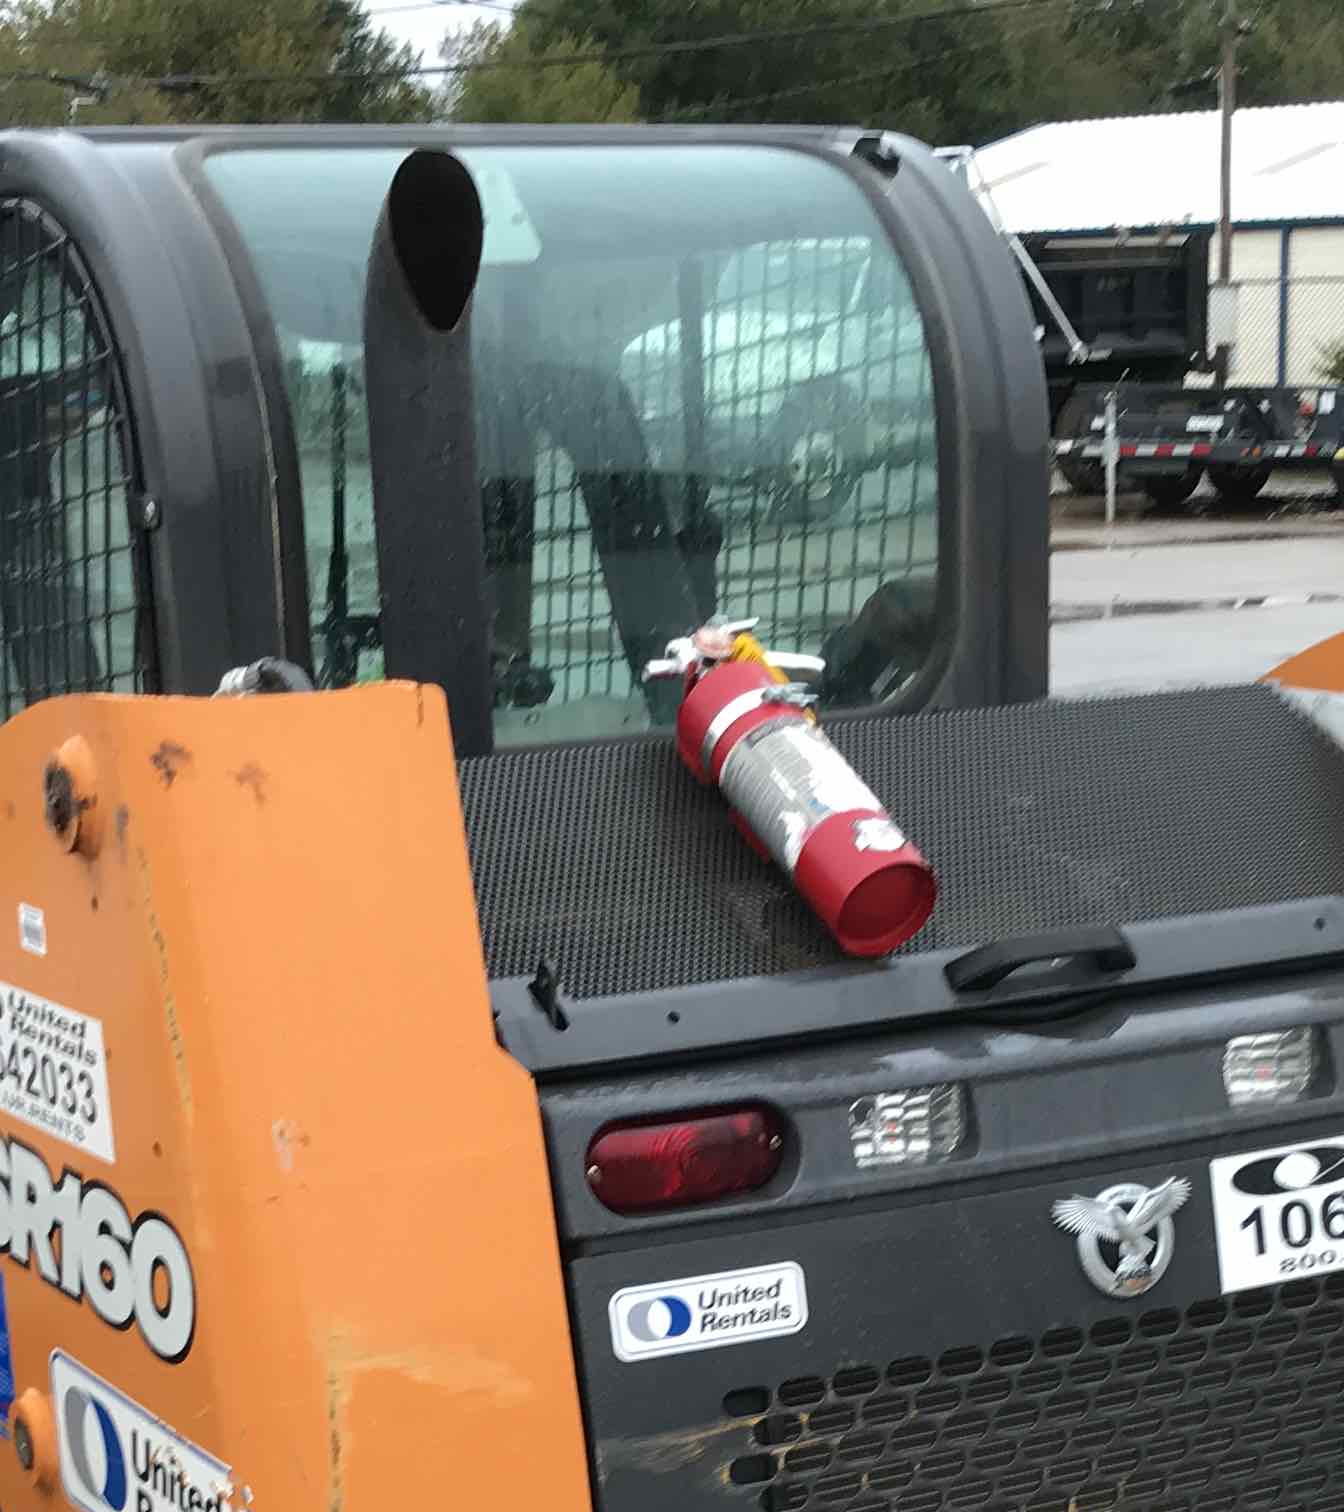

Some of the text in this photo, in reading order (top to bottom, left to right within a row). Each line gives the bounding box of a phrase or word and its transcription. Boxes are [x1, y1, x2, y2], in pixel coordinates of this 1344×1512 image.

[8, 990, 87, 1039] United
[10, 1012, 97, 1066] Rentals
[698, 1278, 783, 1309] United
[700, 1301, 792, 1333] Rentals
